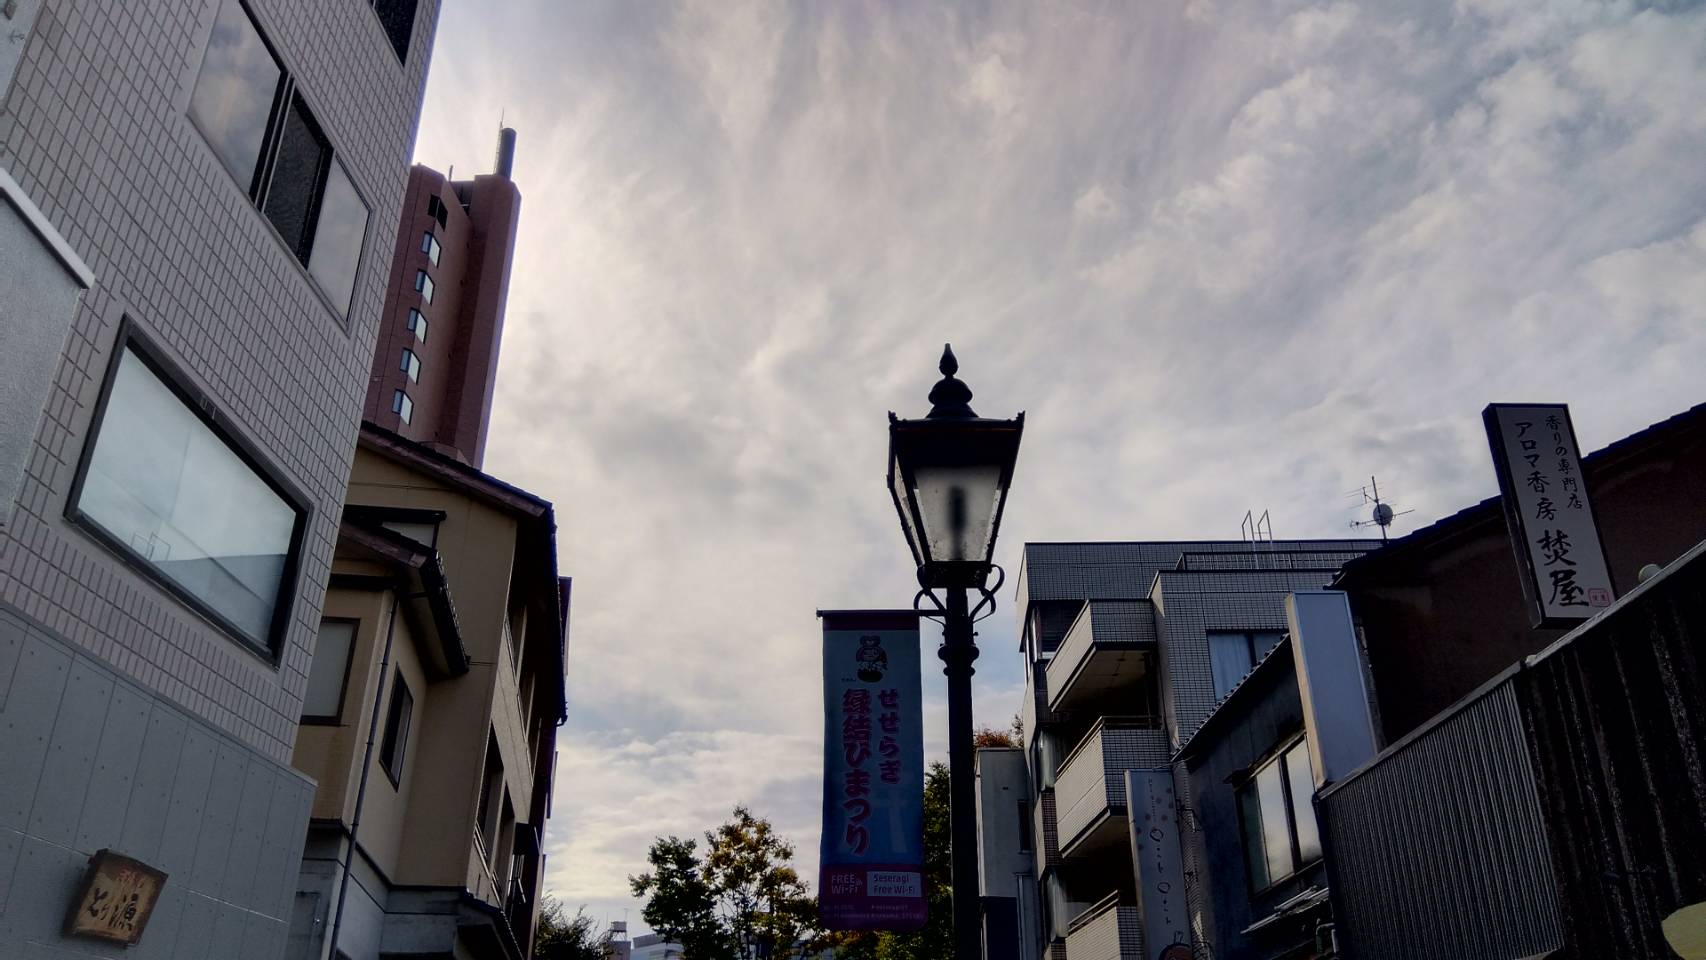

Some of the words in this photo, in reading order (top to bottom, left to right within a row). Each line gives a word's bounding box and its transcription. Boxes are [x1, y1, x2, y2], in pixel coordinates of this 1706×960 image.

[1546, 415, 1583, 509] 香りの専門店
[1515, 422, 1557, 520] アロマ香房
[1537, 529, 1589, 606] 焚屋
[878, 689, 900, 784] せせらぎ
[832, 875, 855, 884] FREE
[832, 885, 858, 895] Wi-Fi
[874, 874, 911, 884] Seseragi
